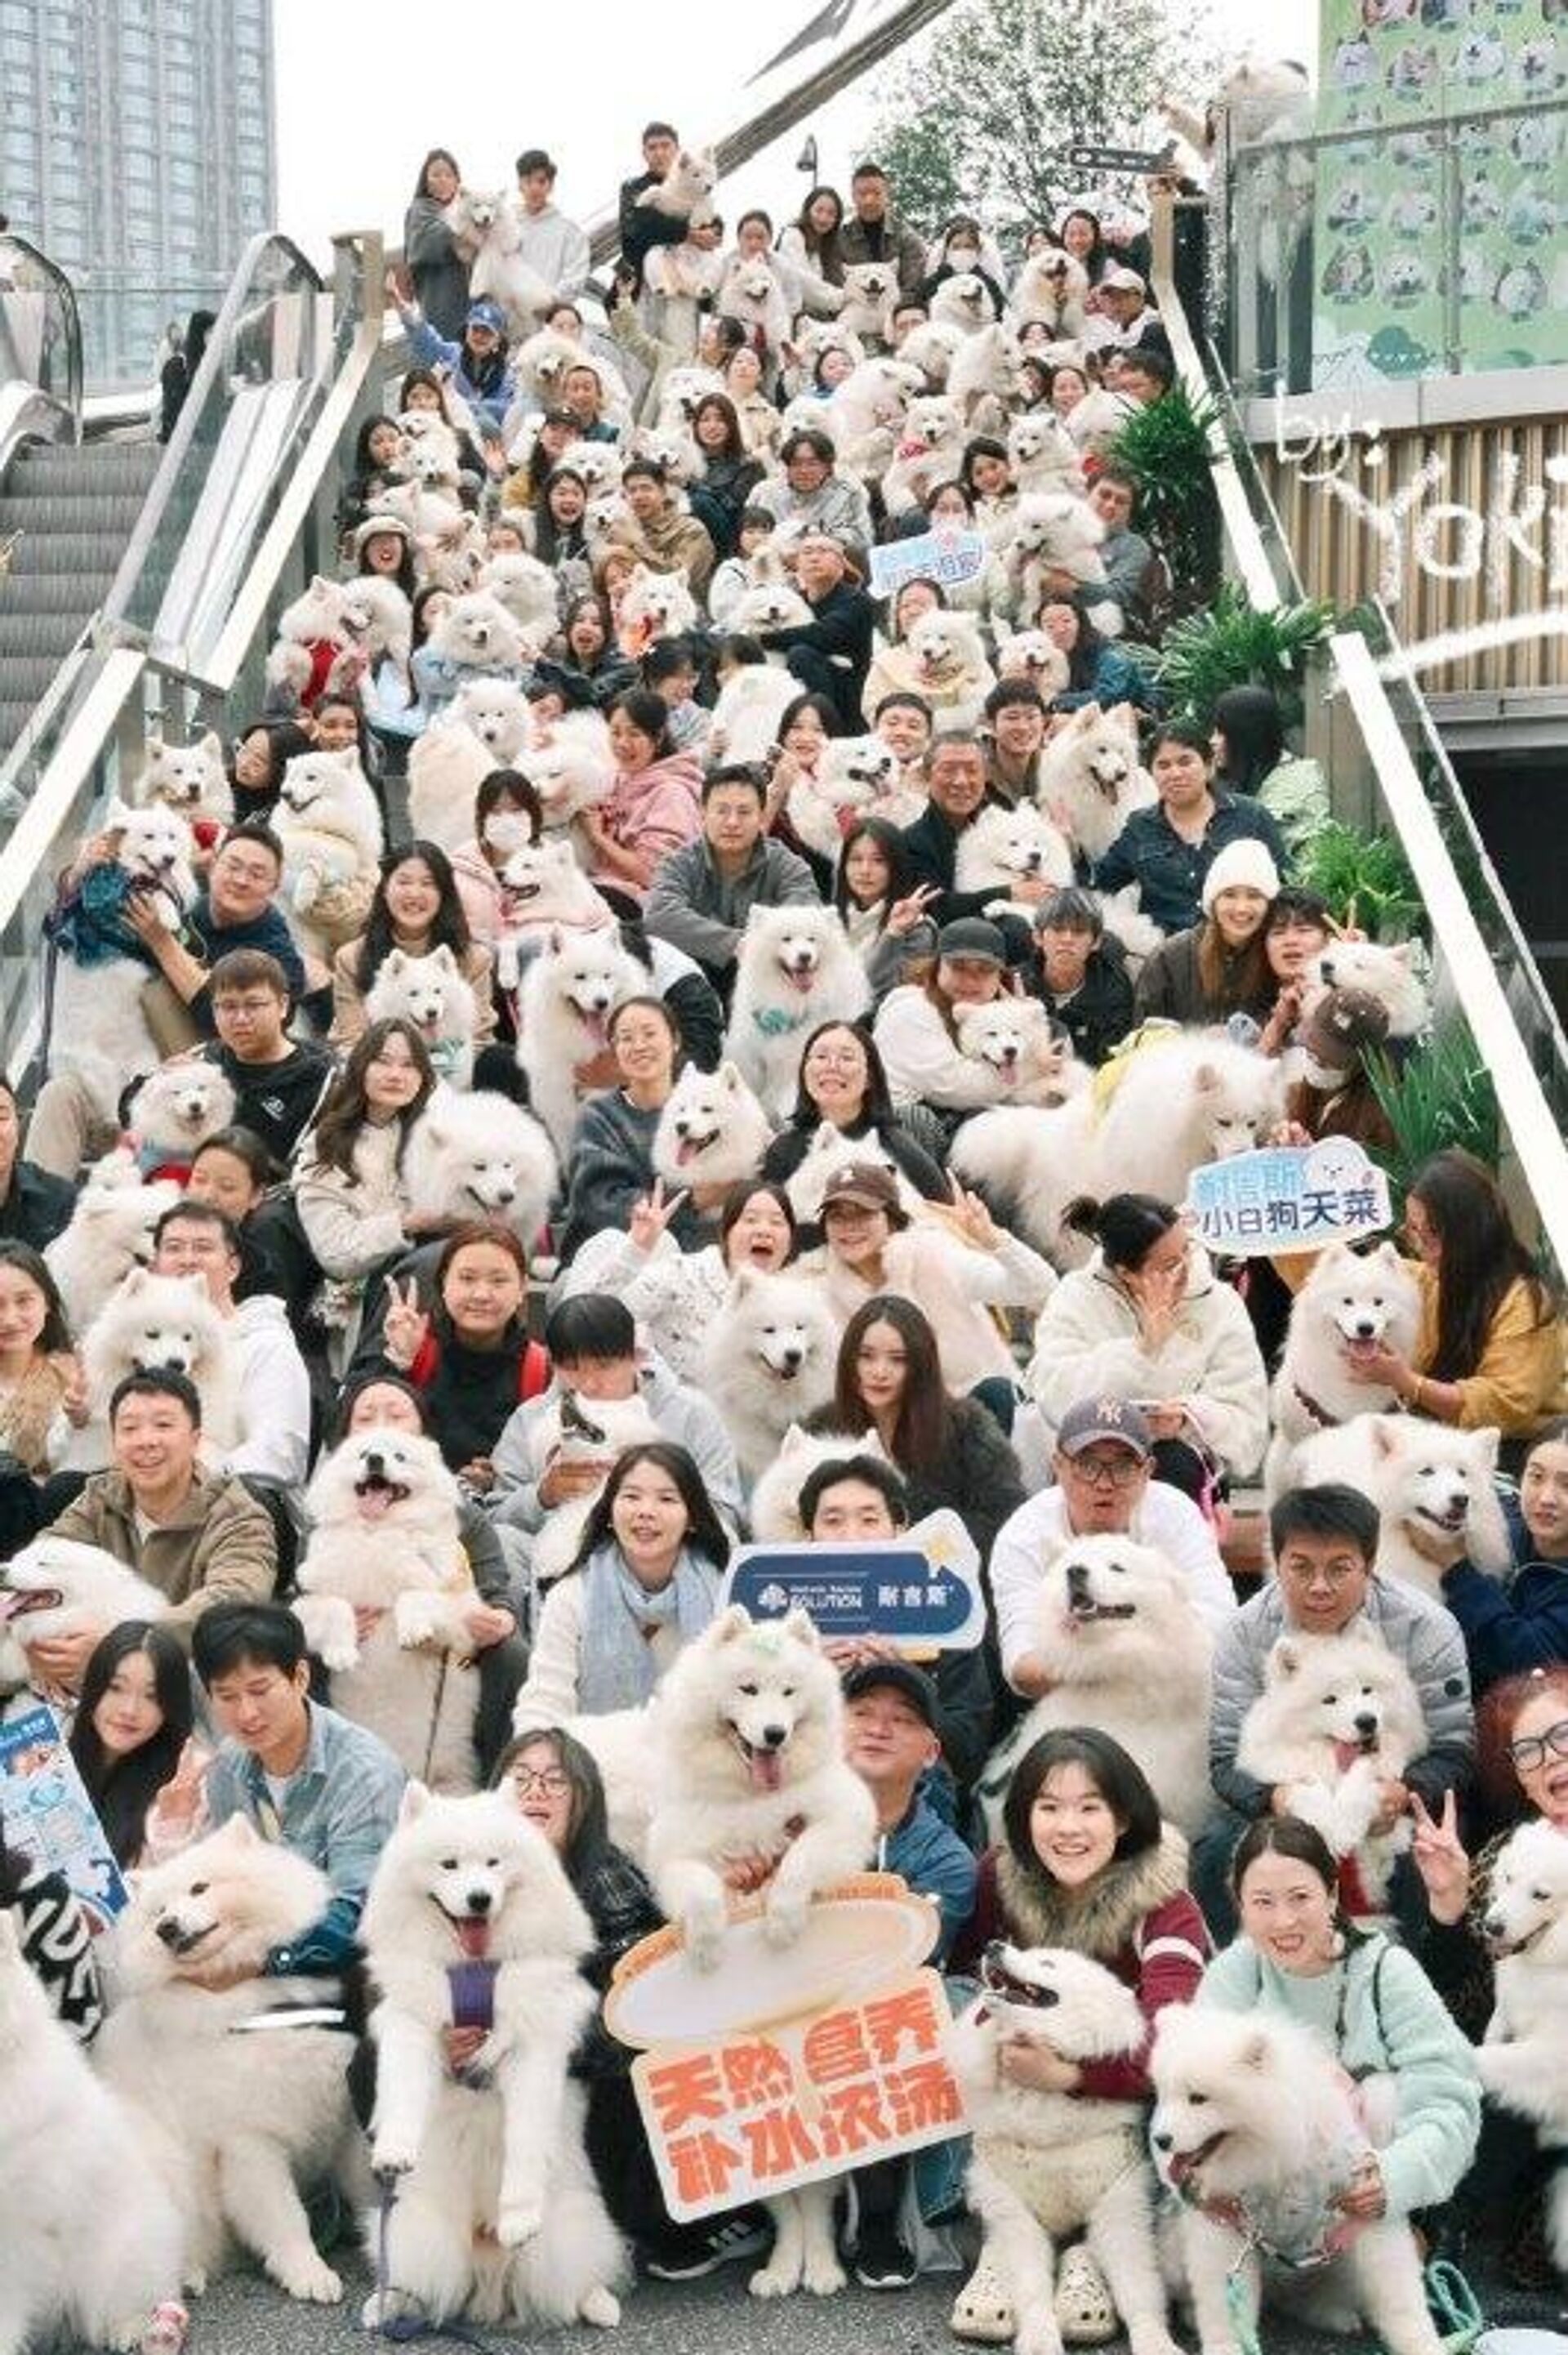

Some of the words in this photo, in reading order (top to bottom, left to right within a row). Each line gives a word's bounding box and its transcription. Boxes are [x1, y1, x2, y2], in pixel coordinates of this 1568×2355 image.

[1202, 1188, 1380, 1238] 小白狗天菜
[668, 2060, 963, 2203] 补水浓汤
